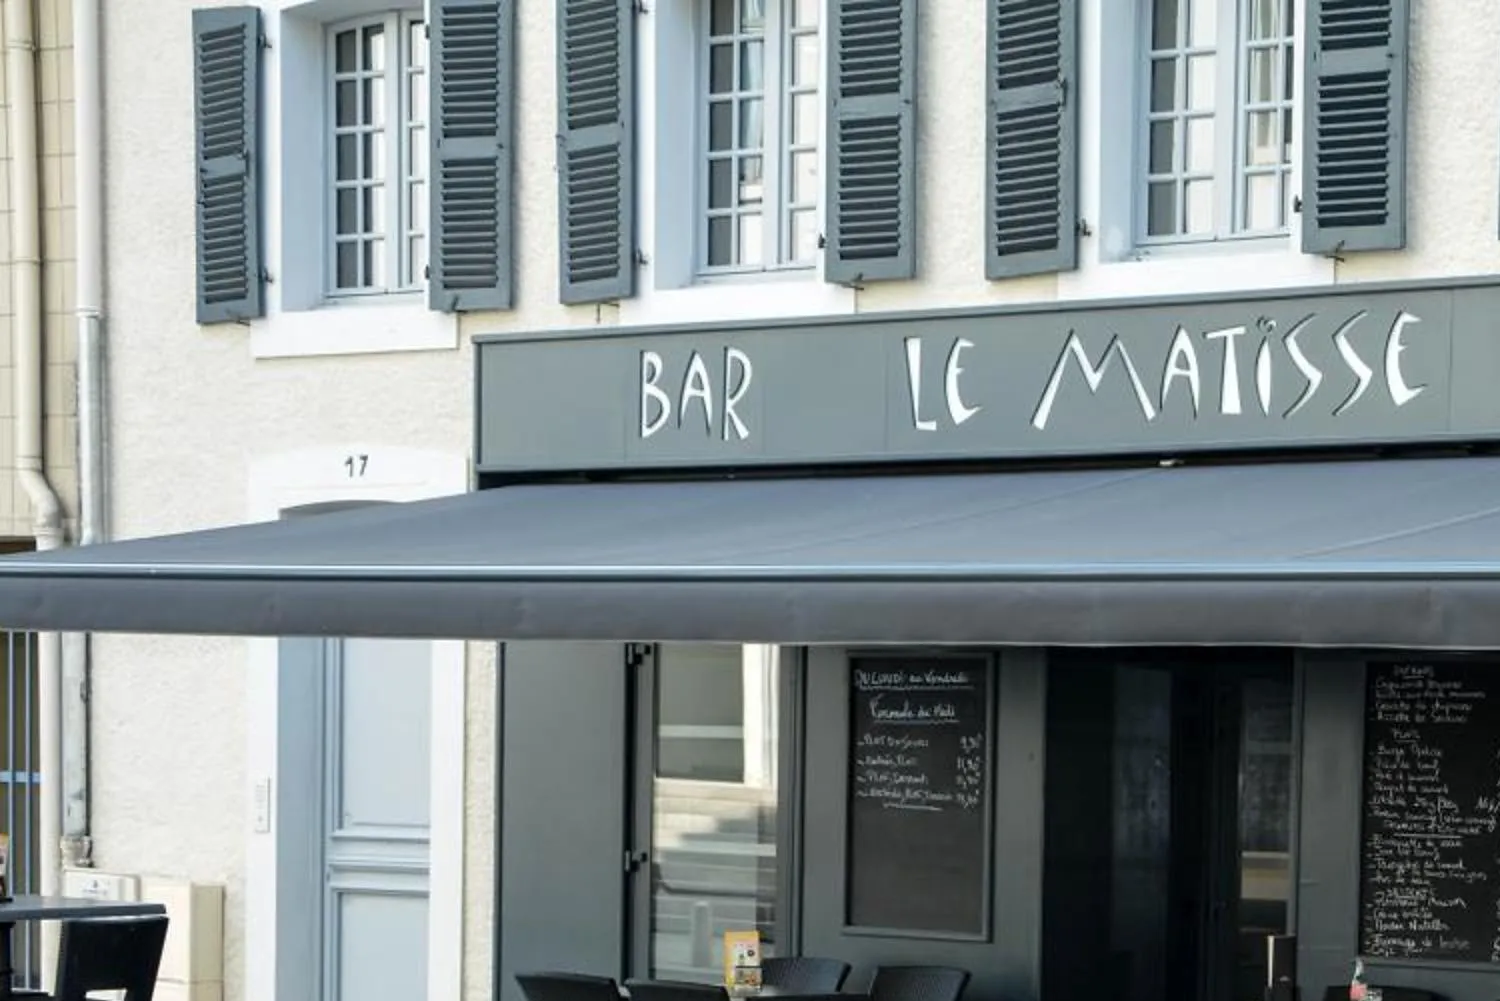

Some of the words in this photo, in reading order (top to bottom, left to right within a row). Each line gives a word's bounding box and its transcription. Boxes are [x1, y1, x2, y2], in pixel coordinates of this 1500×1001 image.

[639, 348, 754, 441] BAR
[904, 335, 986, 432] LE
[345, 454, 368, 477] 17
